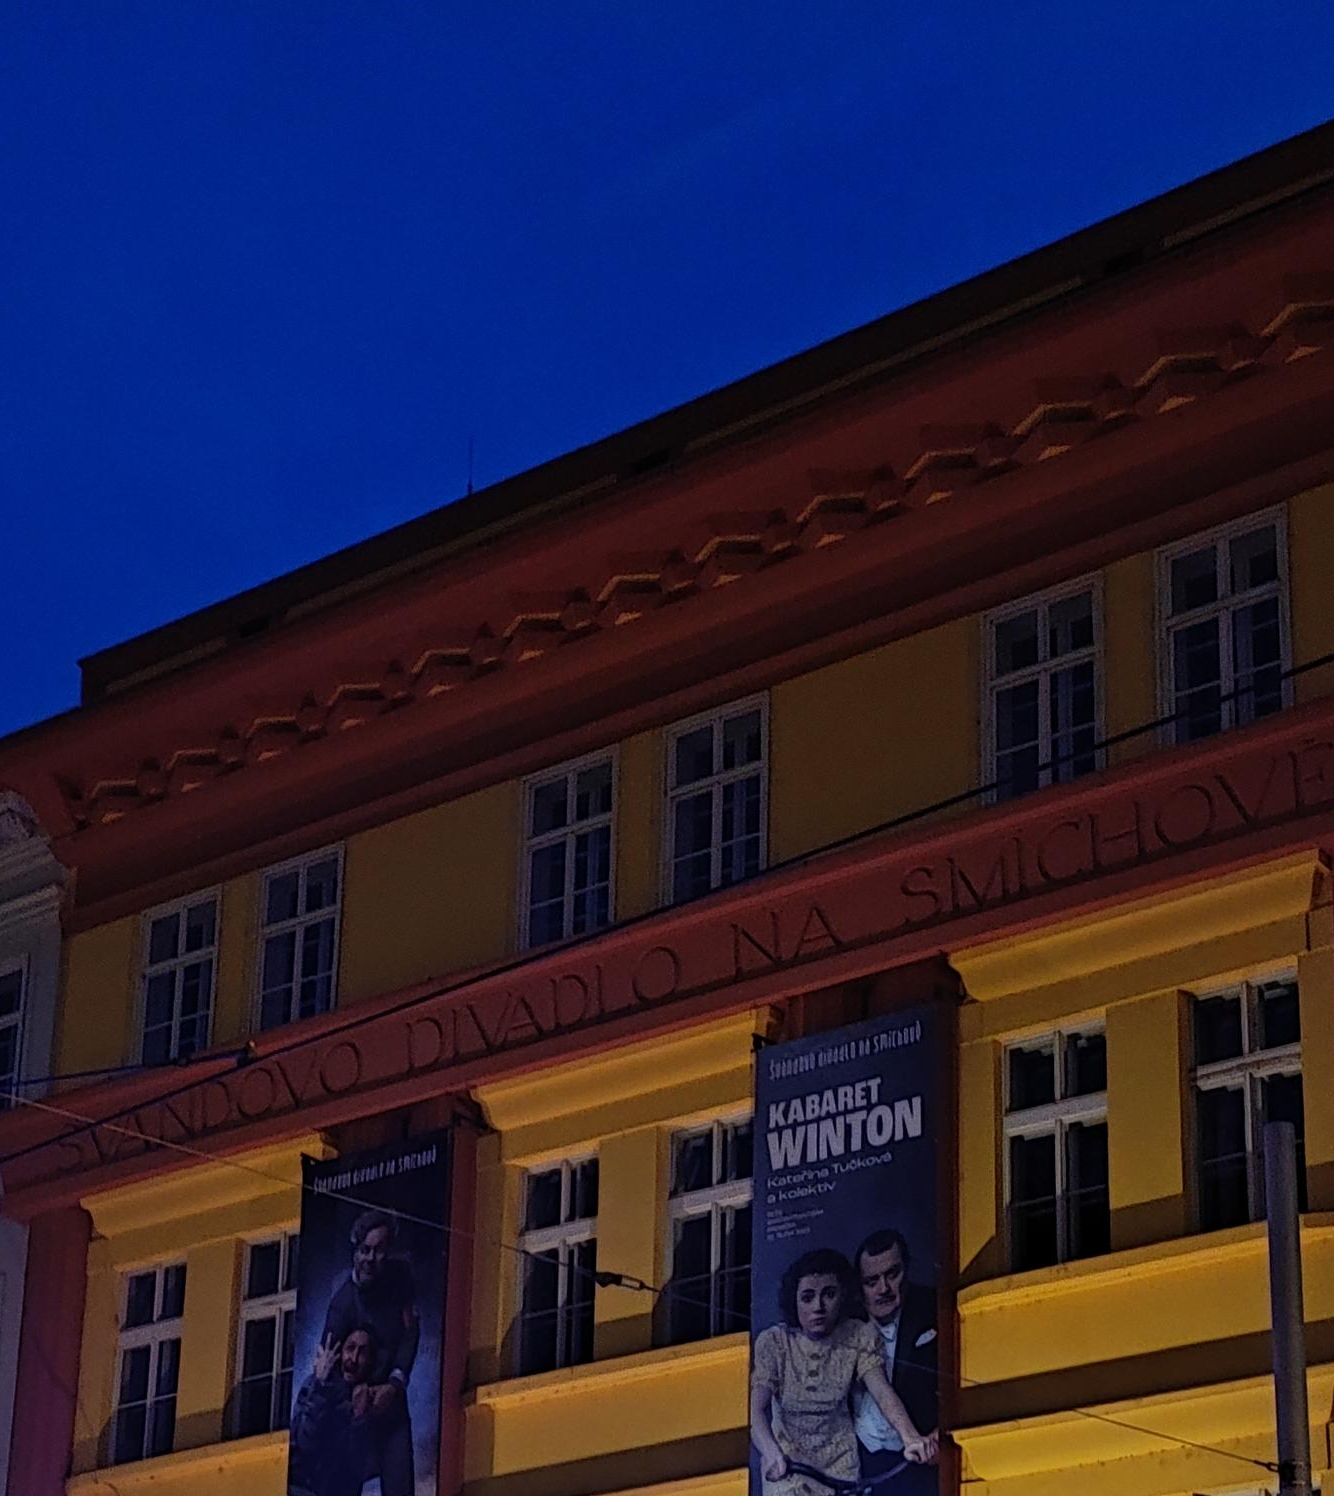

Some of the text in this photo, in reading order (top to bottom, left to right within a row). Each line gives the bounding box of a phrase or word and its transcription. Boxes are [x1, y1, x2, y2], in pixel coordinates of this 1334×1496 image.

[405, 945, 680, 1070] DIVADLO
[730, 905, 845, 981] NA
[769, 1076, 881, 1129] KABARET
[767, 1095, 922, 1171] WINTON
[767, 1167, 829, 1189] Kateřina
[779, 1180, 836, 1200] kolektiv
